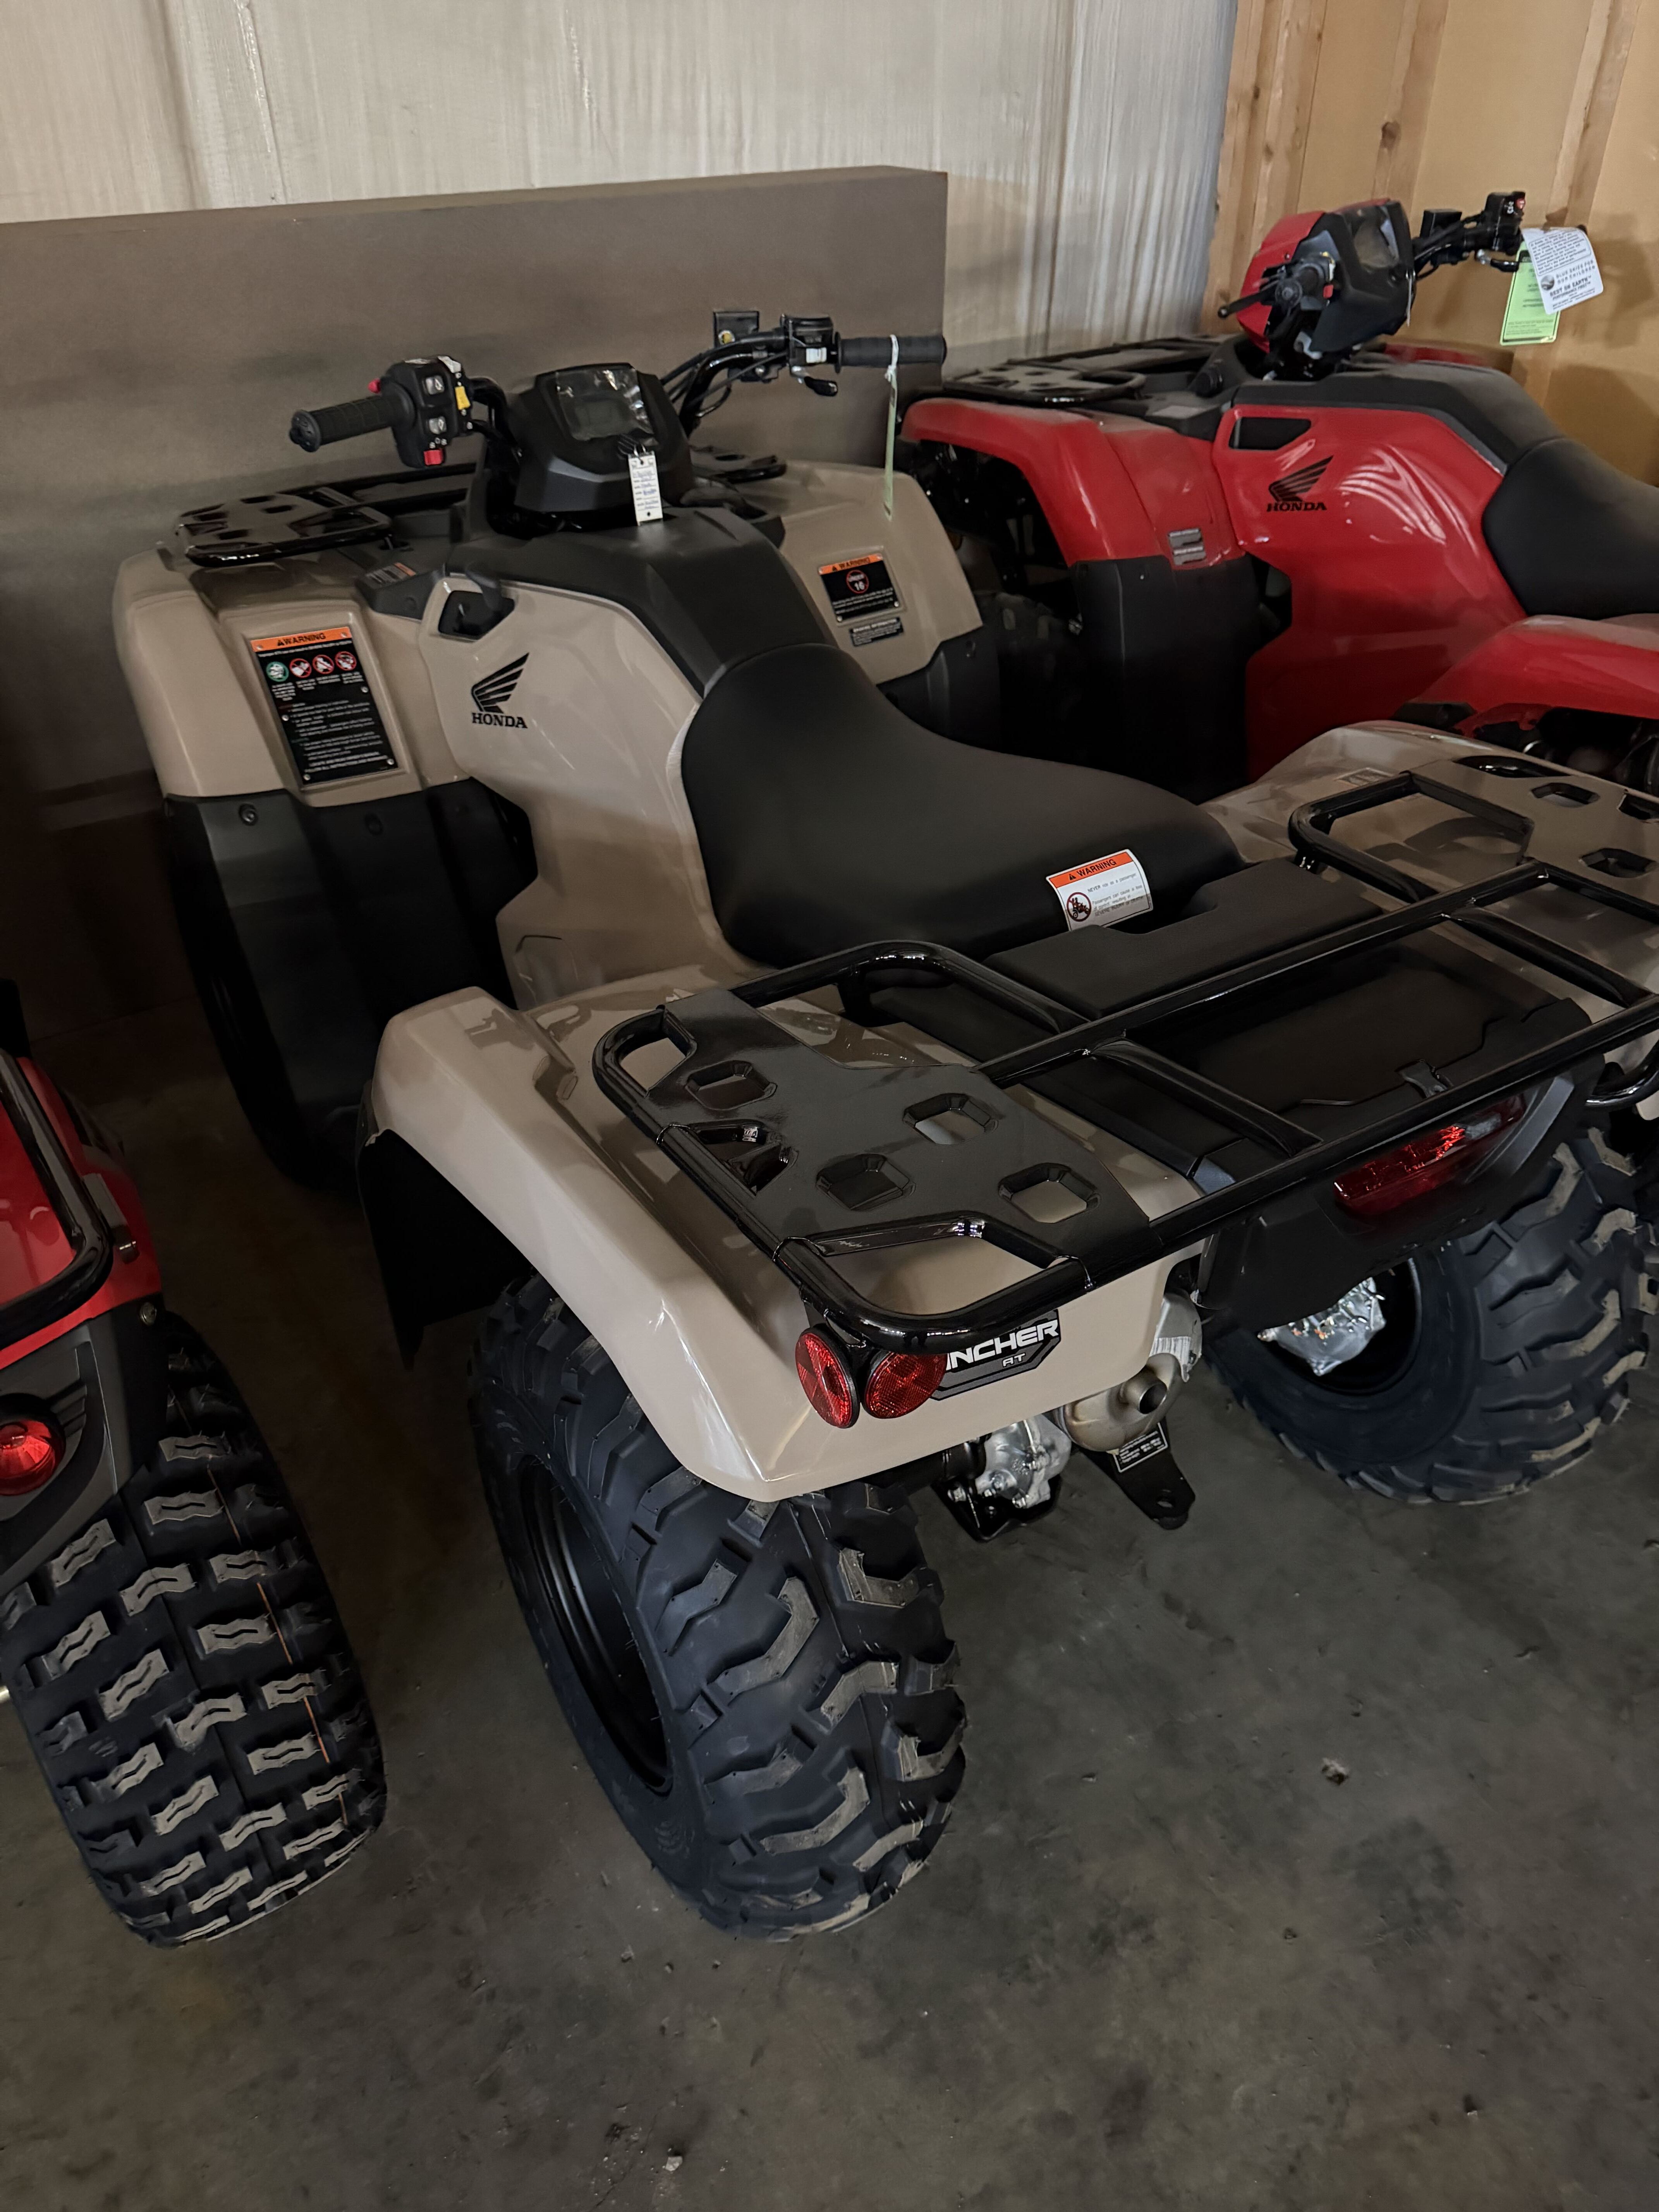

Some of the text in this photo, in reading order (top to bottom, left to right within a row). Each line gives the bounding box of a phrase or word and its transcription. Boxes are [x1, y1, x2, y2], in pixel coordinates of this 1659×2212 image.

[1550, 287, 1562, 297] BEST
[1267, 501, 1327, 512] HONDA
[283, 633, 326, 644] WARNING
[472, 713, 528, 728] HONDA
[1077, 859, 1117, 876] WARNING
[946, 1319, 1059, 1370] NCHER
[1003, 1353, 1025, 1367] AT
